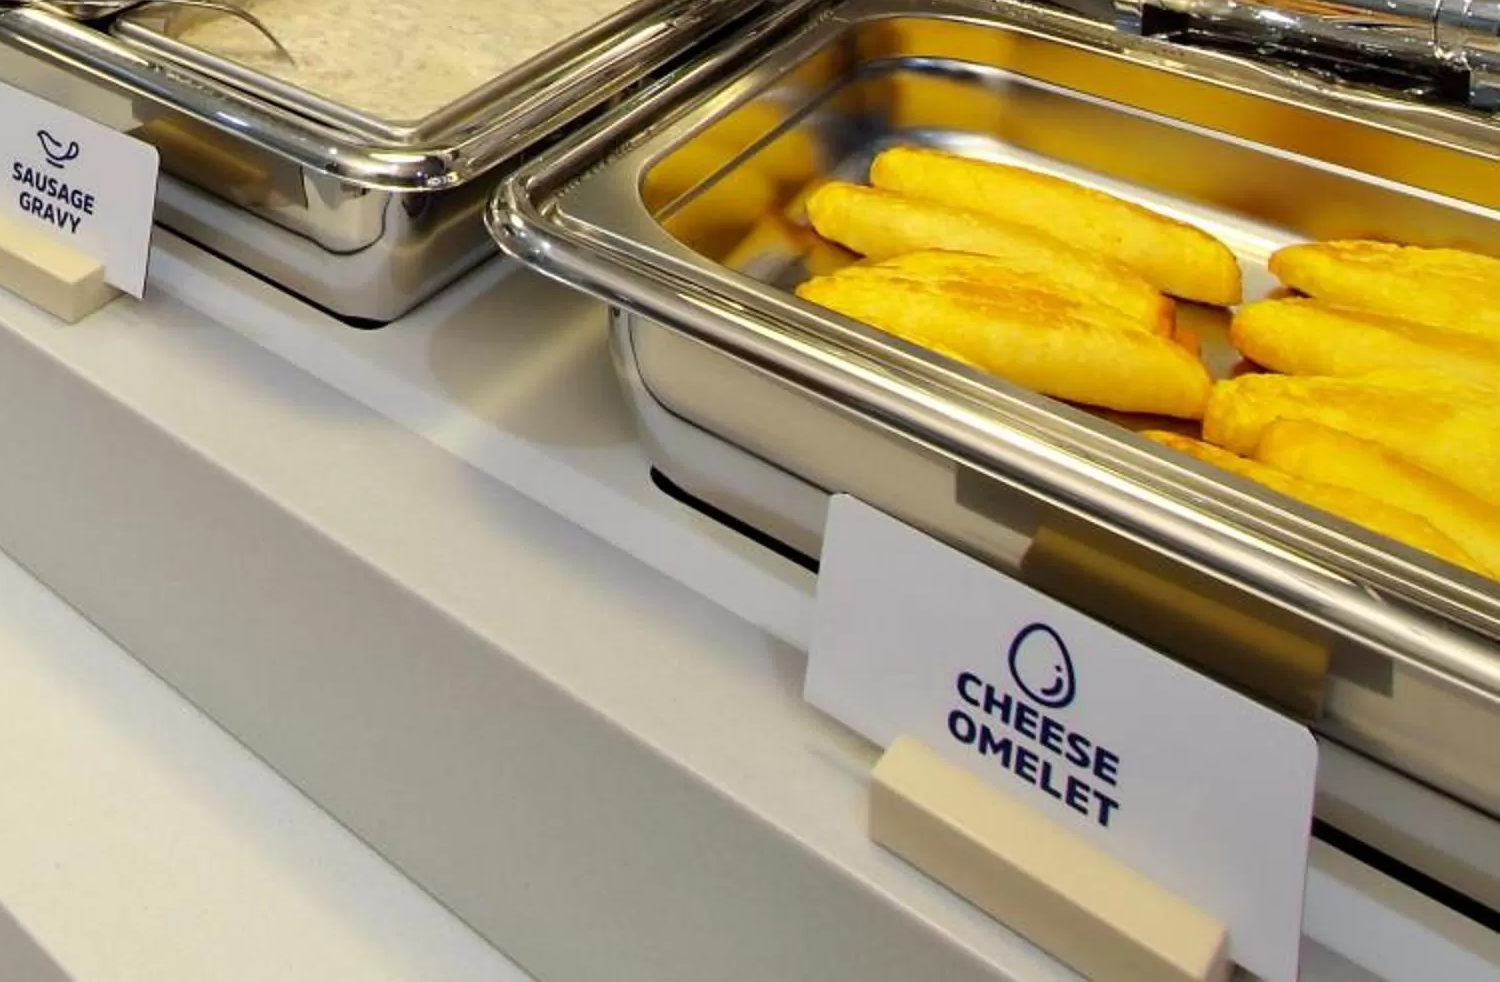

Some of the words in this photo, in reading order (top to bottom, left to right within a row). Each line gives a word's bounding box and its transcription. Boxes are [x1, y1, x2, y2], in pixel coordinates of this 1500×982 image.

[12, 162, 95, 215] SAUSAGE
[19, 191, 81, 234] GRAVY
[948, 709, 1120, 828] OMELET
[956, 671, 1120, 787] CHEESE
